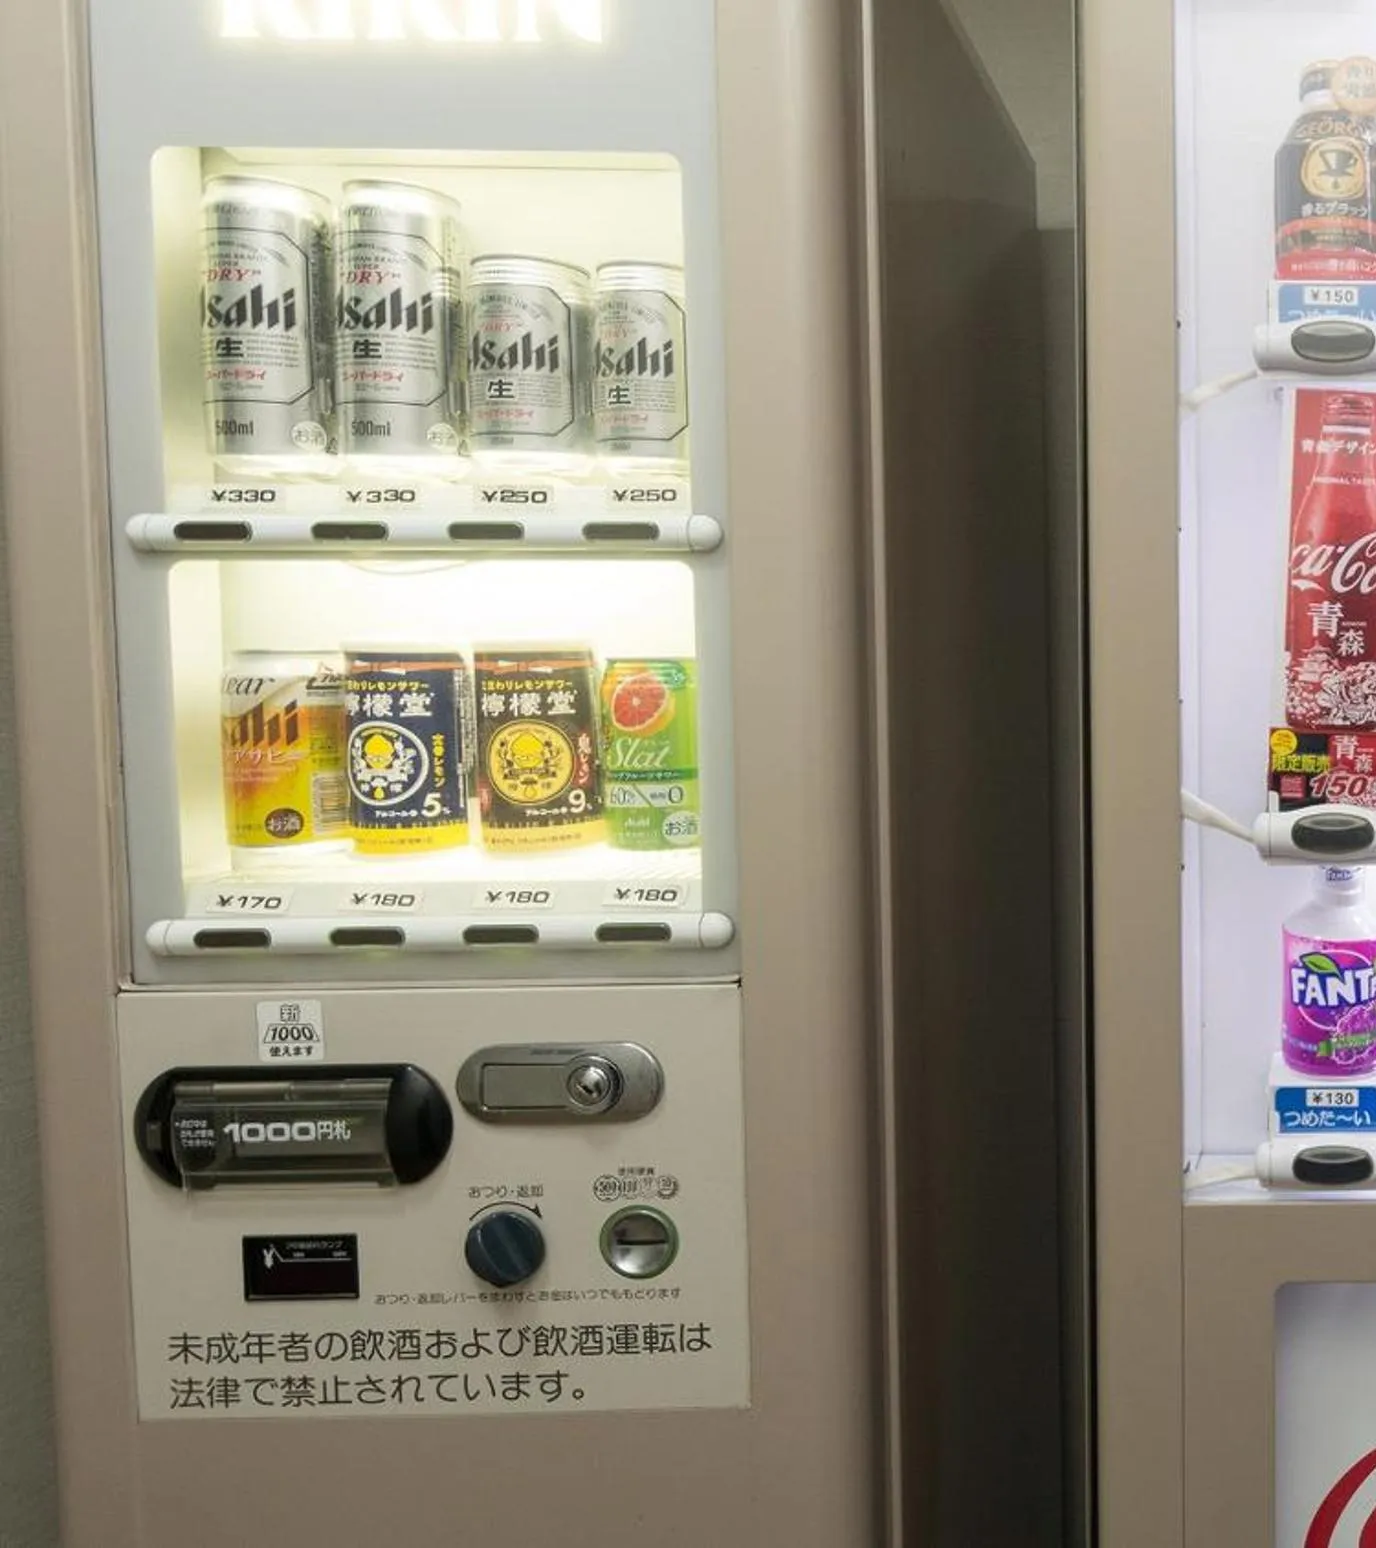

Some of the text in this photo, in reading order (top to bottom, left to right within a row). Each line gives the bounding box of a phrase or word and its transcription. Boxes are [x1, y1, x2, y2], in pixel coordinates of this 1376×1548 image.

[345, 271, 389, 284] DRY
[1309, 289, 1354, 303] ¥150
[215, 337, 244, 358] 生
[353, 339, 382, 359] 生
[487, 380, 515, 399] 生
[607, 386, 632, 405] 生
[214, 421, 255, 436] 500ml
[351, 420, 392, 436] 500ml
[211, 488, 276, 504] ¥330
[346, 489, 415, 504] ¥330
[481, 490, 548, 504] ¥250
[612, 488, 678, 503] ¥250
[607, 738, 671, 769] Slat
[217, 894, 282, 910] ¥170
[350, 892, 416, 907] ¥180
[485, 890, 550, 904] ¥180
[614, 887, 678, 902] ¥180
[279, 1003, 301, 1022] 新
[269, 1025, 315, 1042] 1000
[269, 1044, 315, 1058] 使えます
[1311, 1091, 1355, 1105] ¥130
[222, 1119, 351, 1143] 1000円札
[168, 1322, 712, 1365] 未成年者の飲酒および飲酒運転は
[169, 1369, 586, 1410] 法律で禁止されています。
